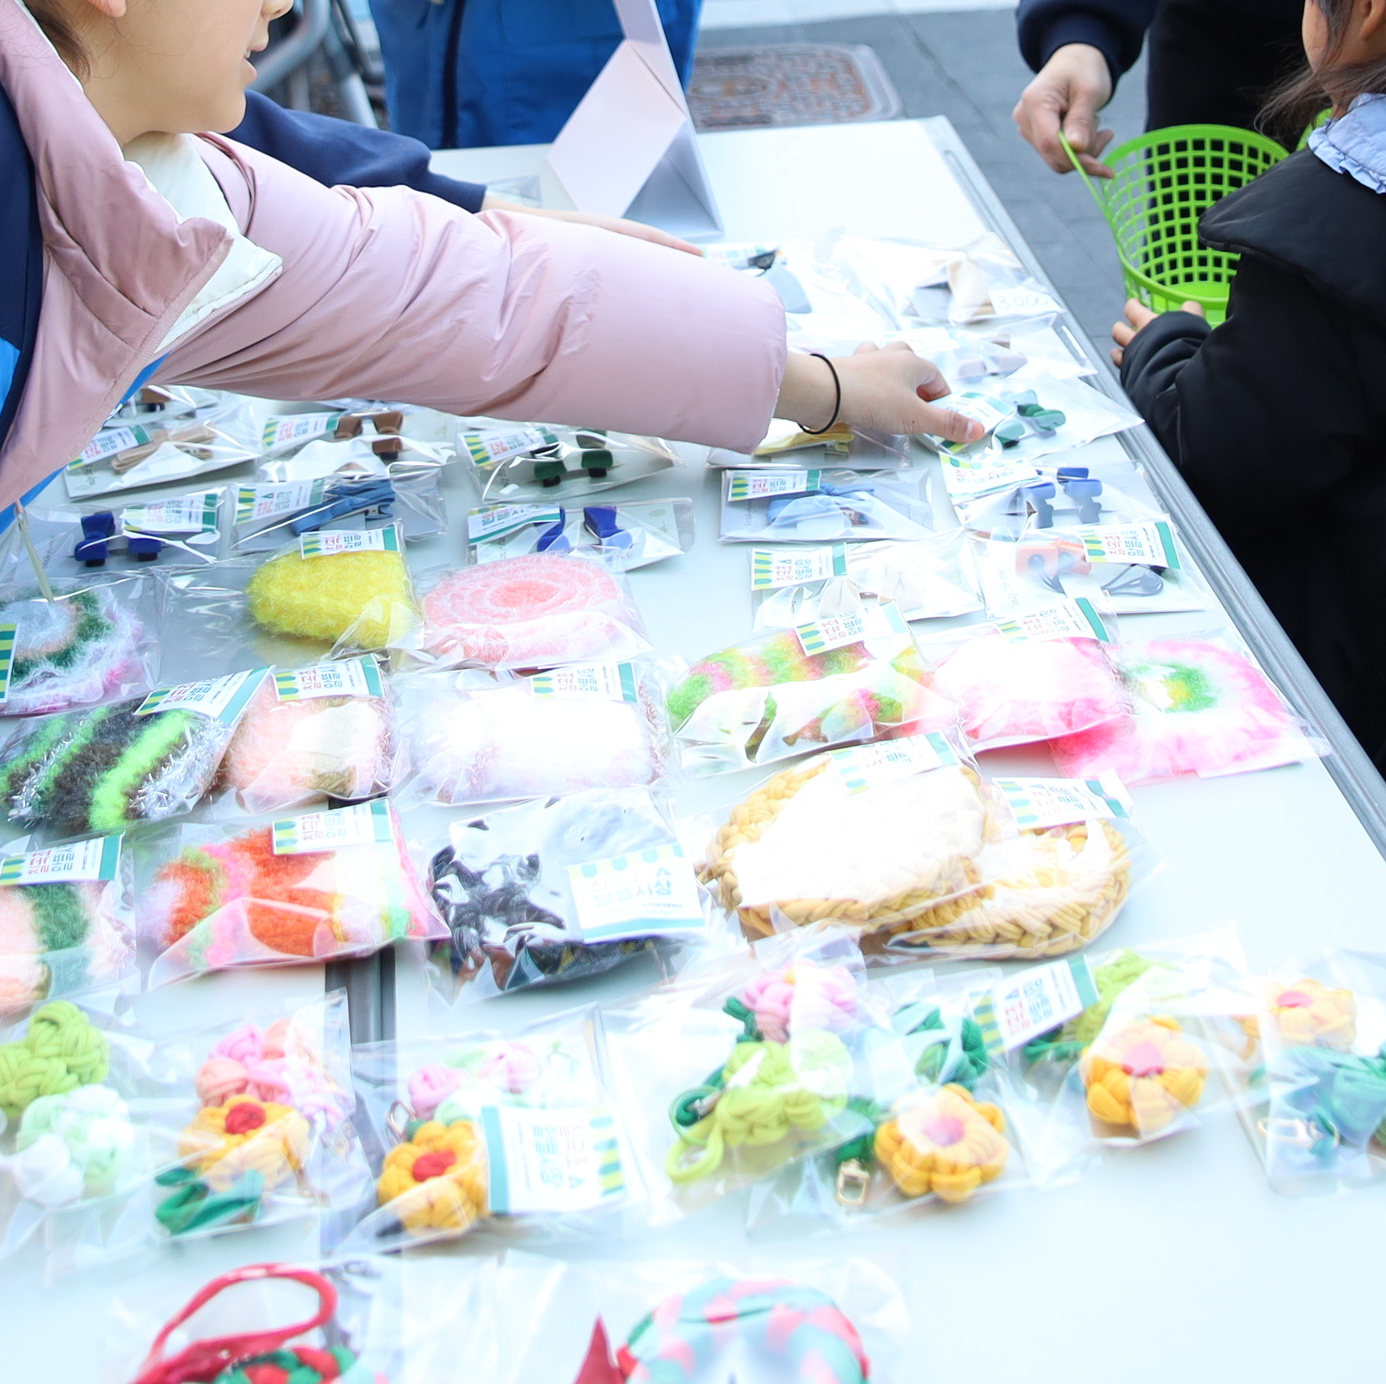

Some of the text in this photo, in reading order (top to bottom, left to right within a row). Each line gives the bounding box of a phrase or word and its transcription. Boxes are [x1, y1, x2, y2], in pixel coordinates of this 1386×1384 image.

[324, 535, 342, 551] 칠곡
[776, 565, 794, 581] 칠곡초
[795, 559, 812, 581] 알뜰시장
[821, 617, 846, 642] 칠곡초
[556, 672, 577, 692] 칠곡초
[594, 877, 673, 908] 알뜰시장
[533, 1125, 563, 1188] 알뜰시장
[559, 1124, 588, 1169] 칠곡초
